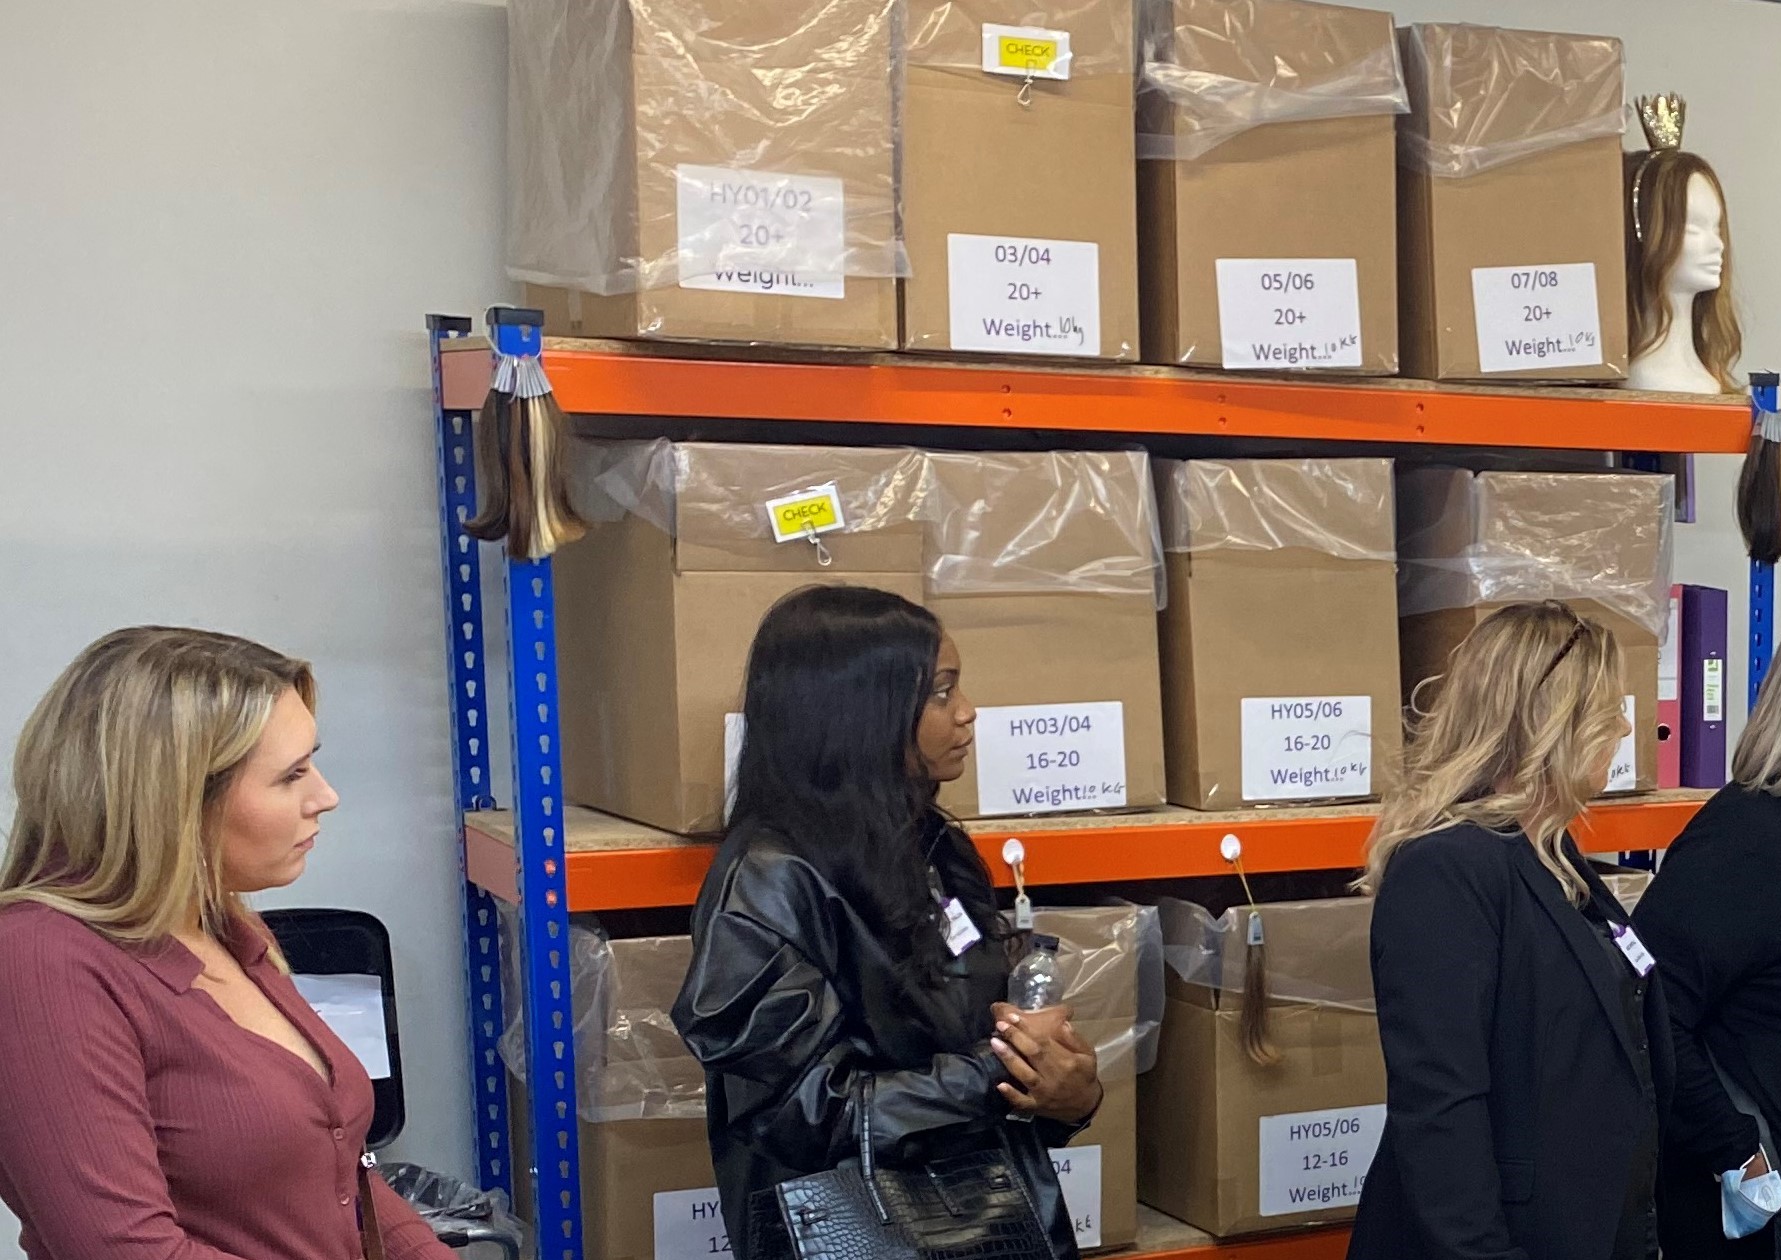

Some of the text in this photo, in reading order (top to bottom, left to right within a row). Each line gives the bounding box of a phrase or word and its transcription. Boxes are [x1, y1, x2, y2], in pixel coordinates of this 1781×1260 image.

[1006, 43, 1050, 57] CHECK
[710, 182, 812, 212] HY01/02
[739, 224, 784, 246] 20+
[995, 245, 1051, 266] 03/04
[1261, 272, 1314, 293] 05/06
[1511, 270, 1558, 291] 07/08
[1008, 283, 1042, 300] 20+
[1274, 309, 1306, 325] 20+
[1523, 306, 1552, 322] 20+
[783, 502, 827, 521] CHECK
[1271, 700, 1342, 721] HY05/06
[1010, 715, 1091, 736] HY03/04
[1284, 734, 1331, 752] 16-20
[1026, 750, 1080, 770] 16-20
[1290, 1118, 1360, 1140] HY05/06
[1303, 1150, 1348, 1170] 12-16
